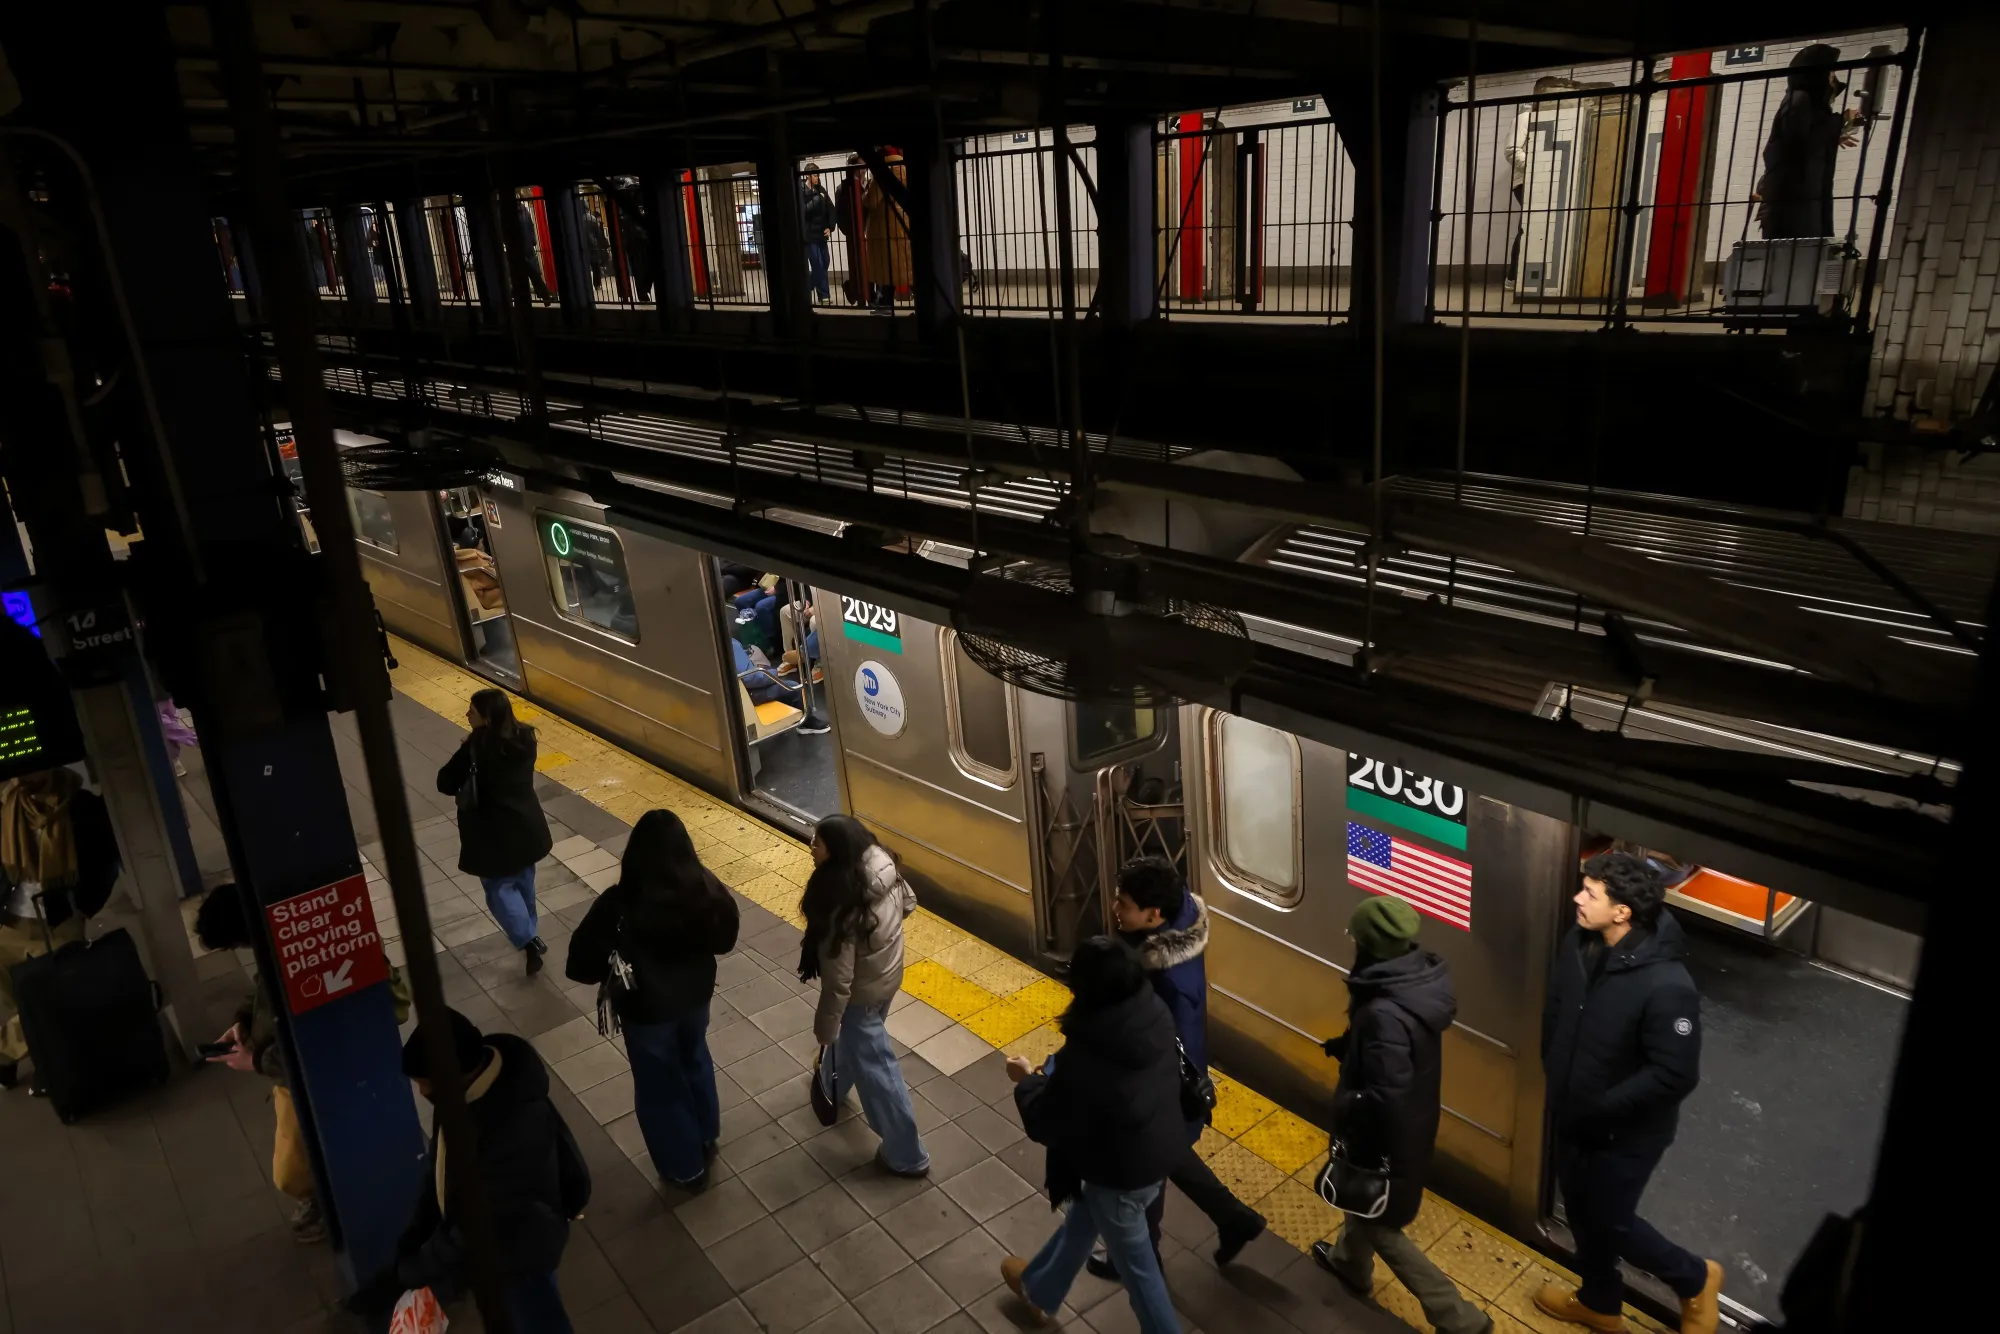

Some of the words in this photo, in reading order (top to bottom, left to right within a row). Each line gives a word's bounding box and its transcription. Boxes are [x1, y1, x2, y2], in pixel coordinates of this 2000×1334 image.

[67, 611, 97, 633] 14
[841, 595, 897, 632] 2029
[72, 626, 133, 650] Street
[864, 695, 876, 706] New
[876, 701, 889, 711] York
[889, 706, 901, 718] City
[864, 704, 887, 720] Subway
[1348, 752, 1464, 816] 2030
[272, 887, 339, 923] Stand
[277, 910, 332, 940] clear
[341, 896, 363, 917] of
[281, 919, 361, 959] moving
[286, 931, 377, 980] platform
